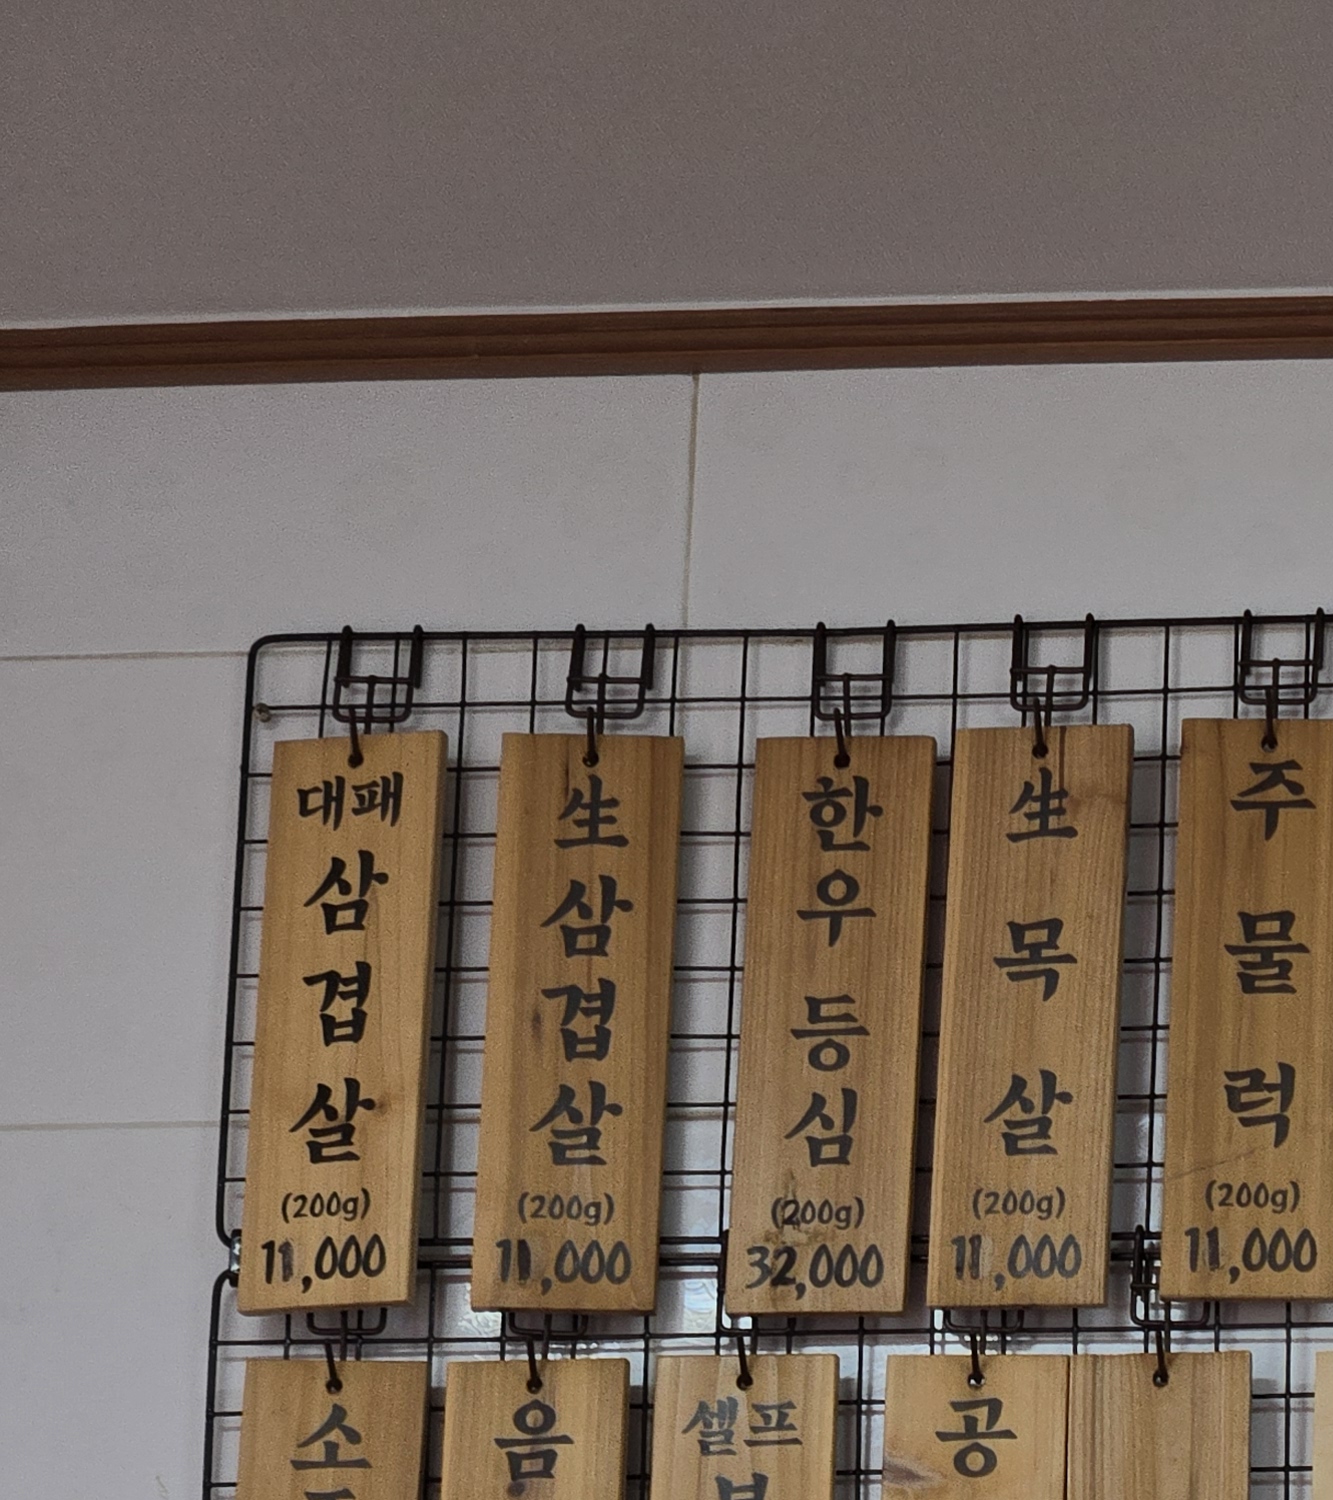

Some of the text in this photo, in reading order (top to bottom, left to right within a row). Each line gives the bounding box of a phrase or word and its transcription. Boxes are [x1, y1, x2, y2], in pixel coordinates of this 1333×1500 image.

[296, 771, 404, 831] 대패
[1219, 758, 1317, 1149] 주물럭
[288, 849, 389, 1165] 삼겹살
[281, 1187, 371, 1224] (200g)
[517, 1191, 615, 1227] (200g)
[771, 1195, 865, 1232] (200g)
[972, 1186, 1066, 1221] (200g)
[1204, 1179, 1301, 1215] (200g)
[261, 1233, 387, 1294] 11,000
[495, 1238, 632, 1297] 11,000
[745, 1243, 884, 1301] 32,000
[950, 1233, 1082, 1292] 11,000
[1184, 1225, 1318, 1285] 11,000
[681, 1396, 804, 1457] 셀프
